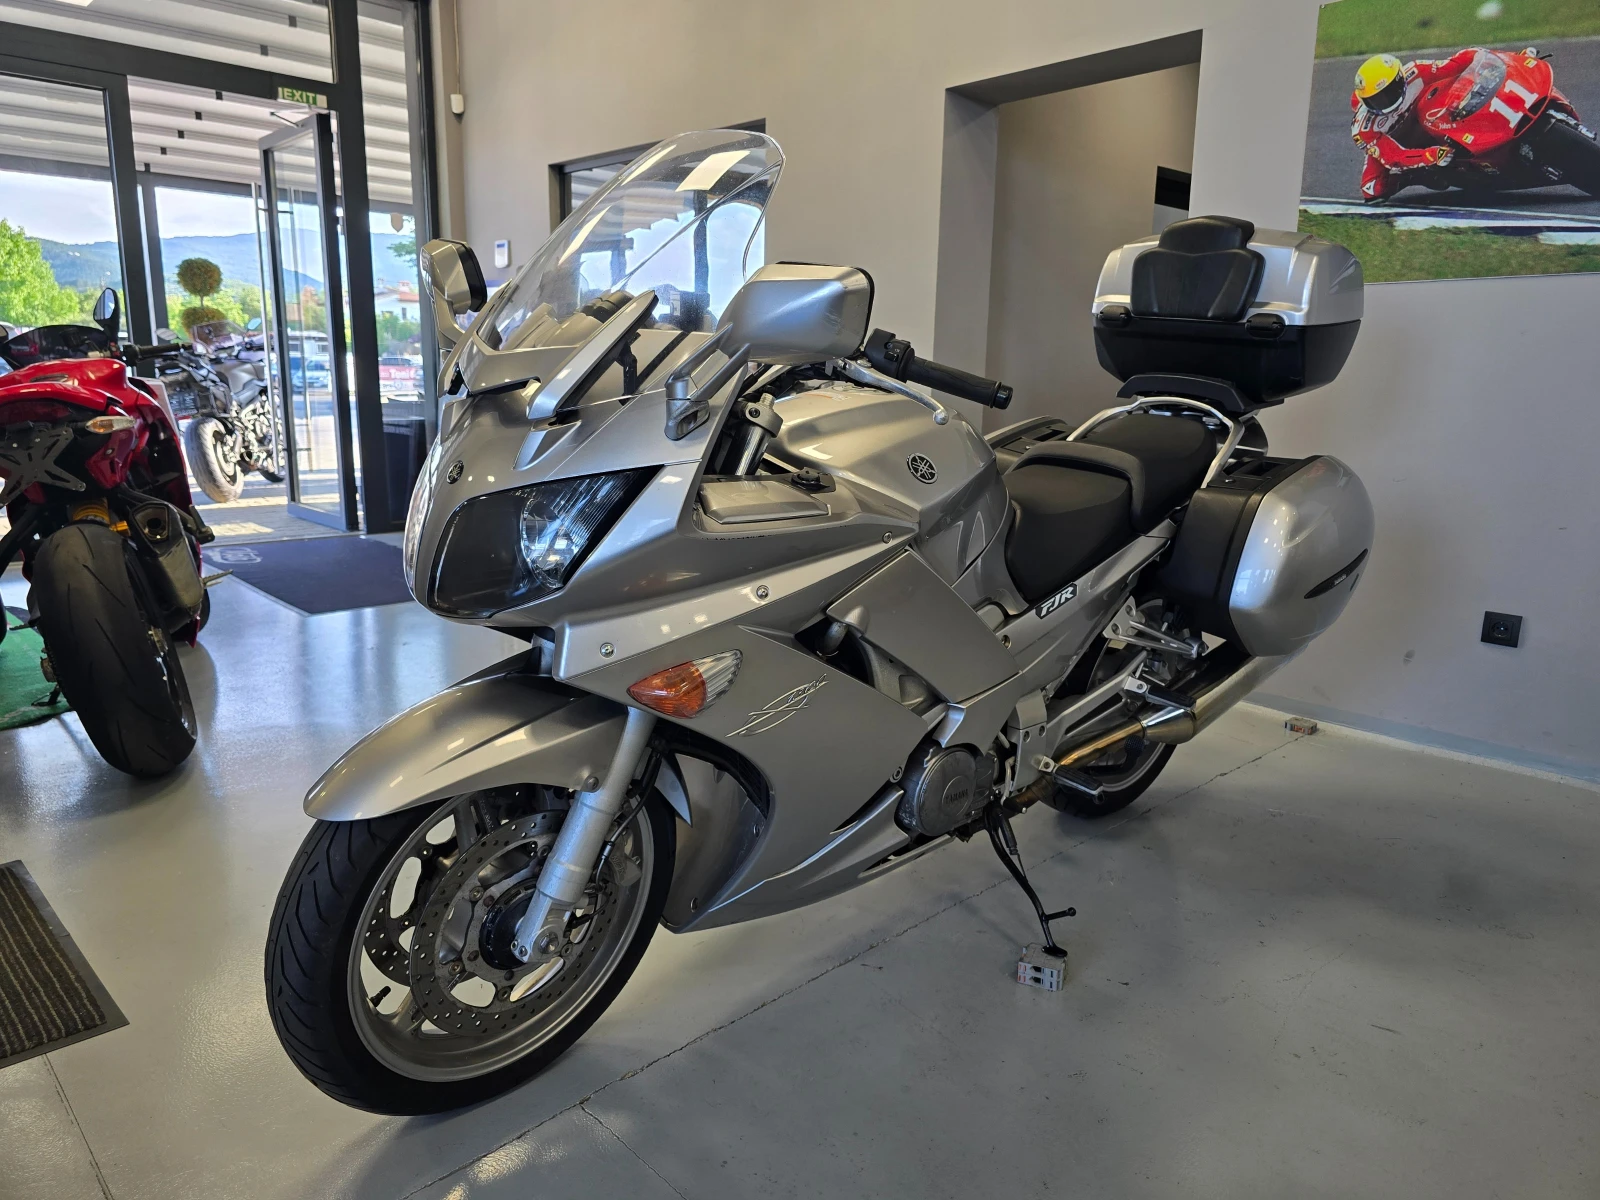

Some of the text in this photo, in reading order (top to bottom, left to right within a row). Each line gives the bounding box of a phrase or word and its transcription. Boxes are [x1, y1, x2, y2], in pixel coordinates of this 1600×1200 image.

[283, 87, 316, 105] EXIT
[1489, 79, 1539, 129] 11
[1040, 586, 1074, 617] FJR
